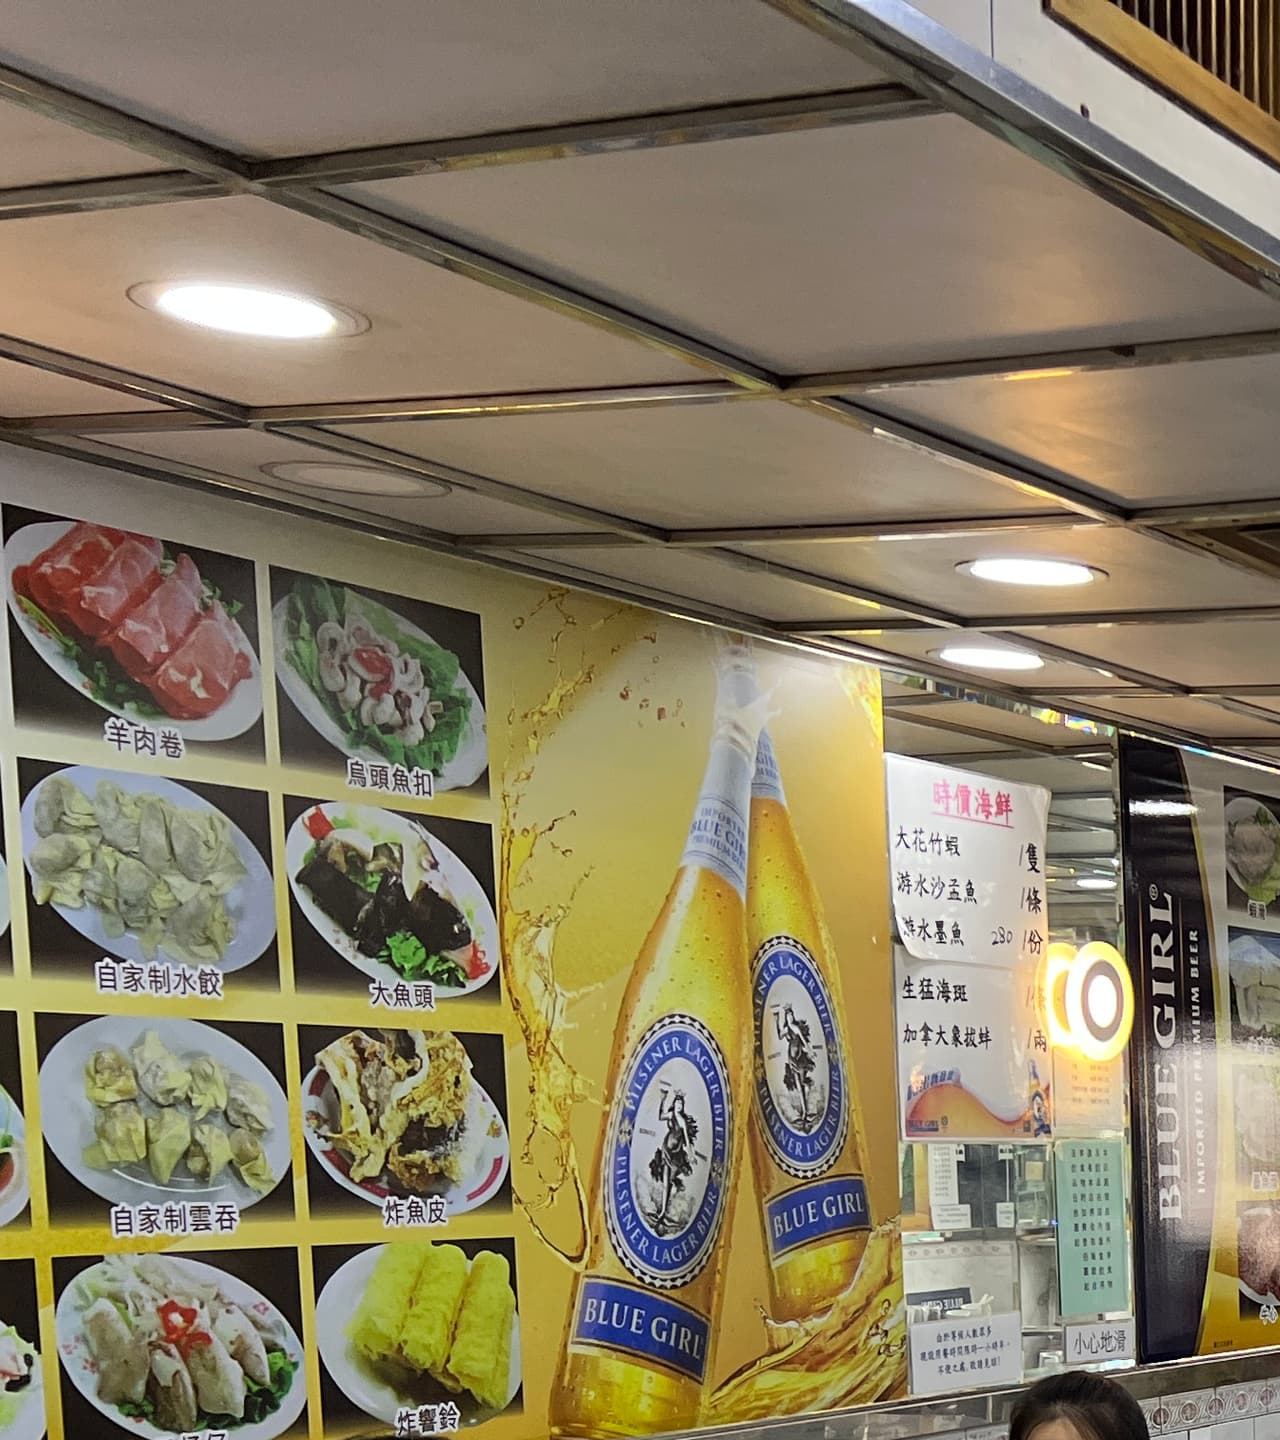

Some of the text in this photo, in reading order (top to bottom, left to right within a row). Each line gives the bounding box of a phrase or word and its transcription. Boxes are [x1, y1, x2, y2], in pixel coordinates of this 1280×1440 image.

[107, 720, 183, 758] 羊肉卷
[348, 761, 432, 797] 烏頭魚扣
[933, 779, 1013, 824] 時價海鮮
[895, 825, 960, 857] 大花竹蝦
[991, 926, 1013, 945] 280
[1188, 929, 1199, 978] BEER
[97, 963, 222, 996] 自家制水餃
[779, 956, 816, 991] LAGER
[902, 976, 968, 1003] 生猛海斑
[371, 981, 434, 1009] 大魚頭
[903, 1022, 992, 1050] 加拿大象拔蚌
[625, 1036, 682, 1111] PILSENER
[685, 1038, 720, 1098] LAGER
[1150, 892, 1182, 1220] BLUE GIRL
[806, 1116, 839, 1157] LAGER
[113, 1205, 238, 1236] 自家制雲吞
[384, 1197, 446, 1226] 炸魚皮
[616, 1156, 718, 1264] PILSENER LAGER BIER
[773, 1191, 866, 1239] BLUE GIRL
[584, 1297, 703, 1360] BLUE GIRL
[1073, 1329, 1127, 1356] 小心地滑
[397, 1403, 458, 1432] 炸響鈴
